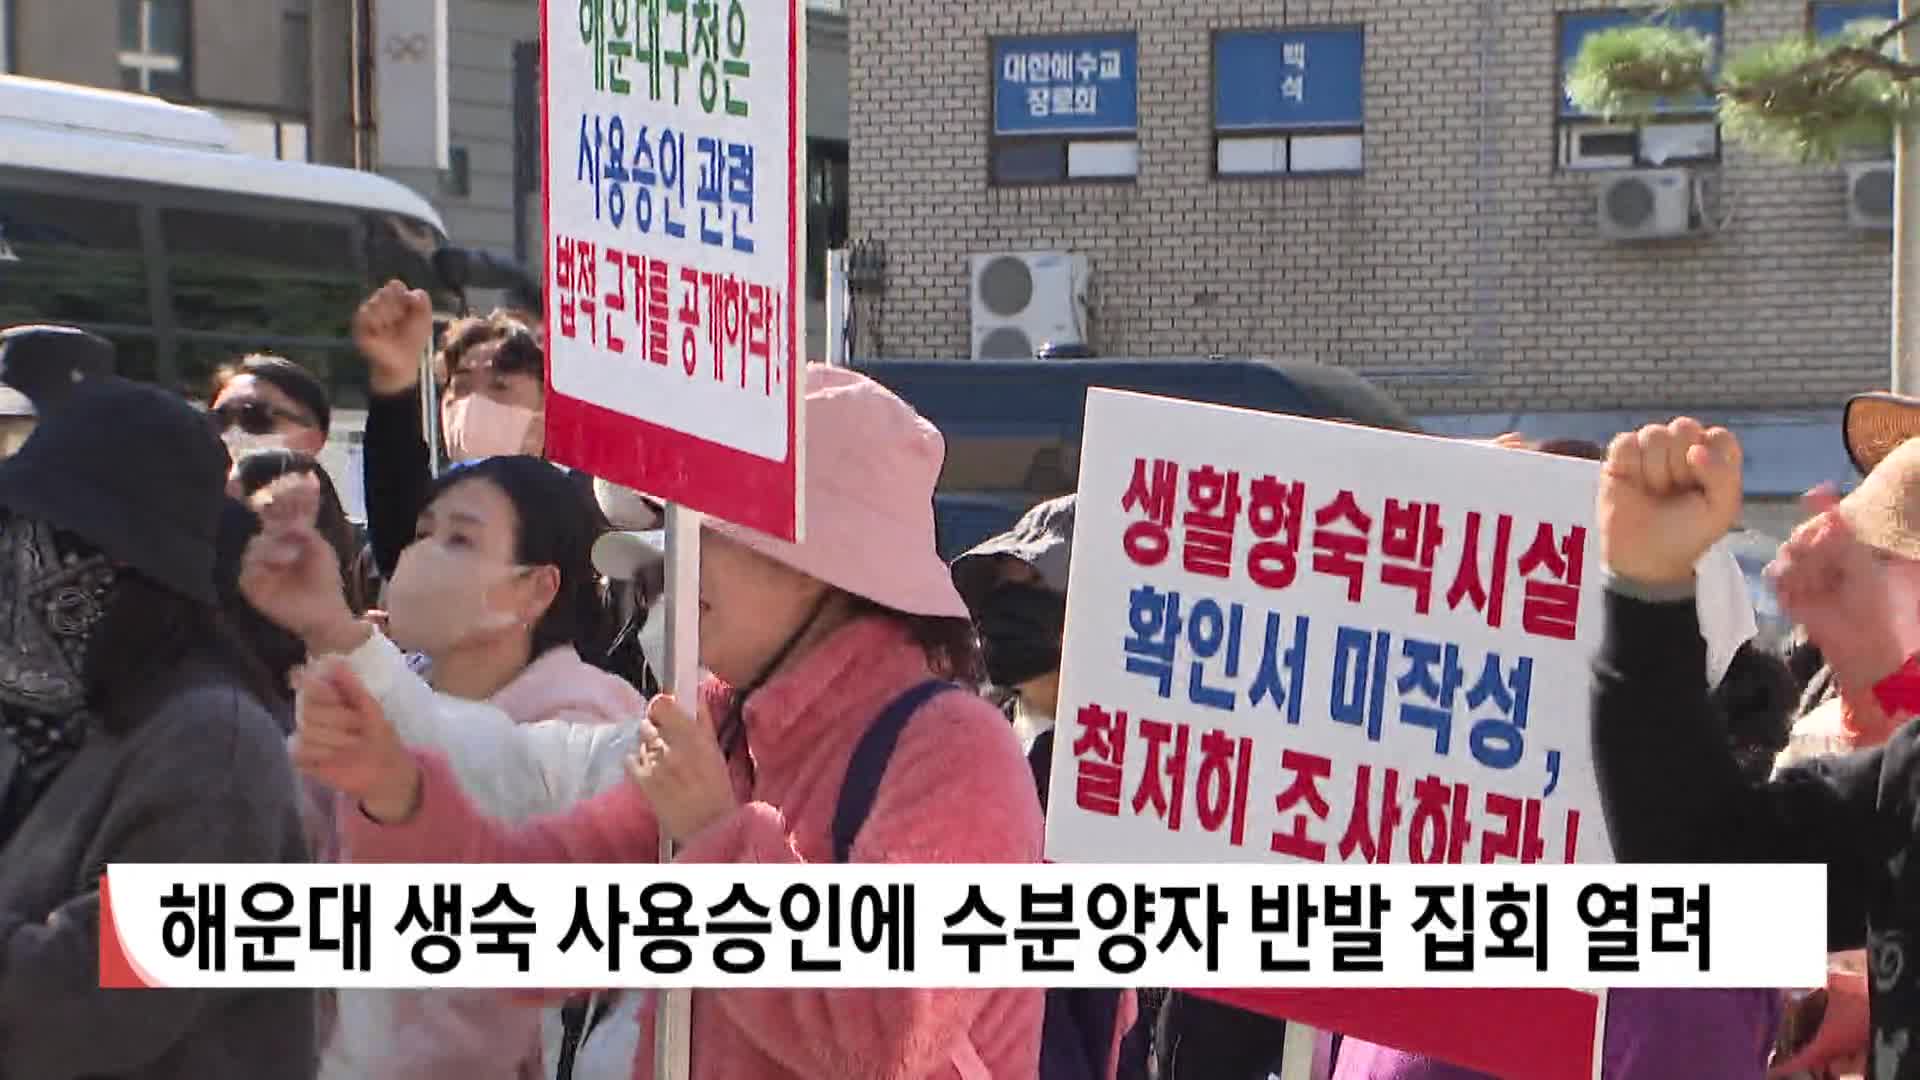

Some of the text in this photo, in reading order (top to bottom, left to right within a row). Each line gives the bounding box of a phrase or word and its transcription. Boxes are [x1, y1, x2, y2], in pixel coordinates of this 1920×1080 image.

[579, 0, 751, 117] 해운대구청은
[1003, 49, 1121, 83] 대한예수교
[1027, 85, 1098, 116] 장로회
[578, 113, 755, 254] 사용승인 관련
[556, 234, 783, 396] 법적 근거를 공개하라!
[1121, 456, 1588, 641] 생활형숙박시설
[1123, 584, 1562, 799] 확인서 미작성,
[1072, 703, 1254, 848] 철저히
